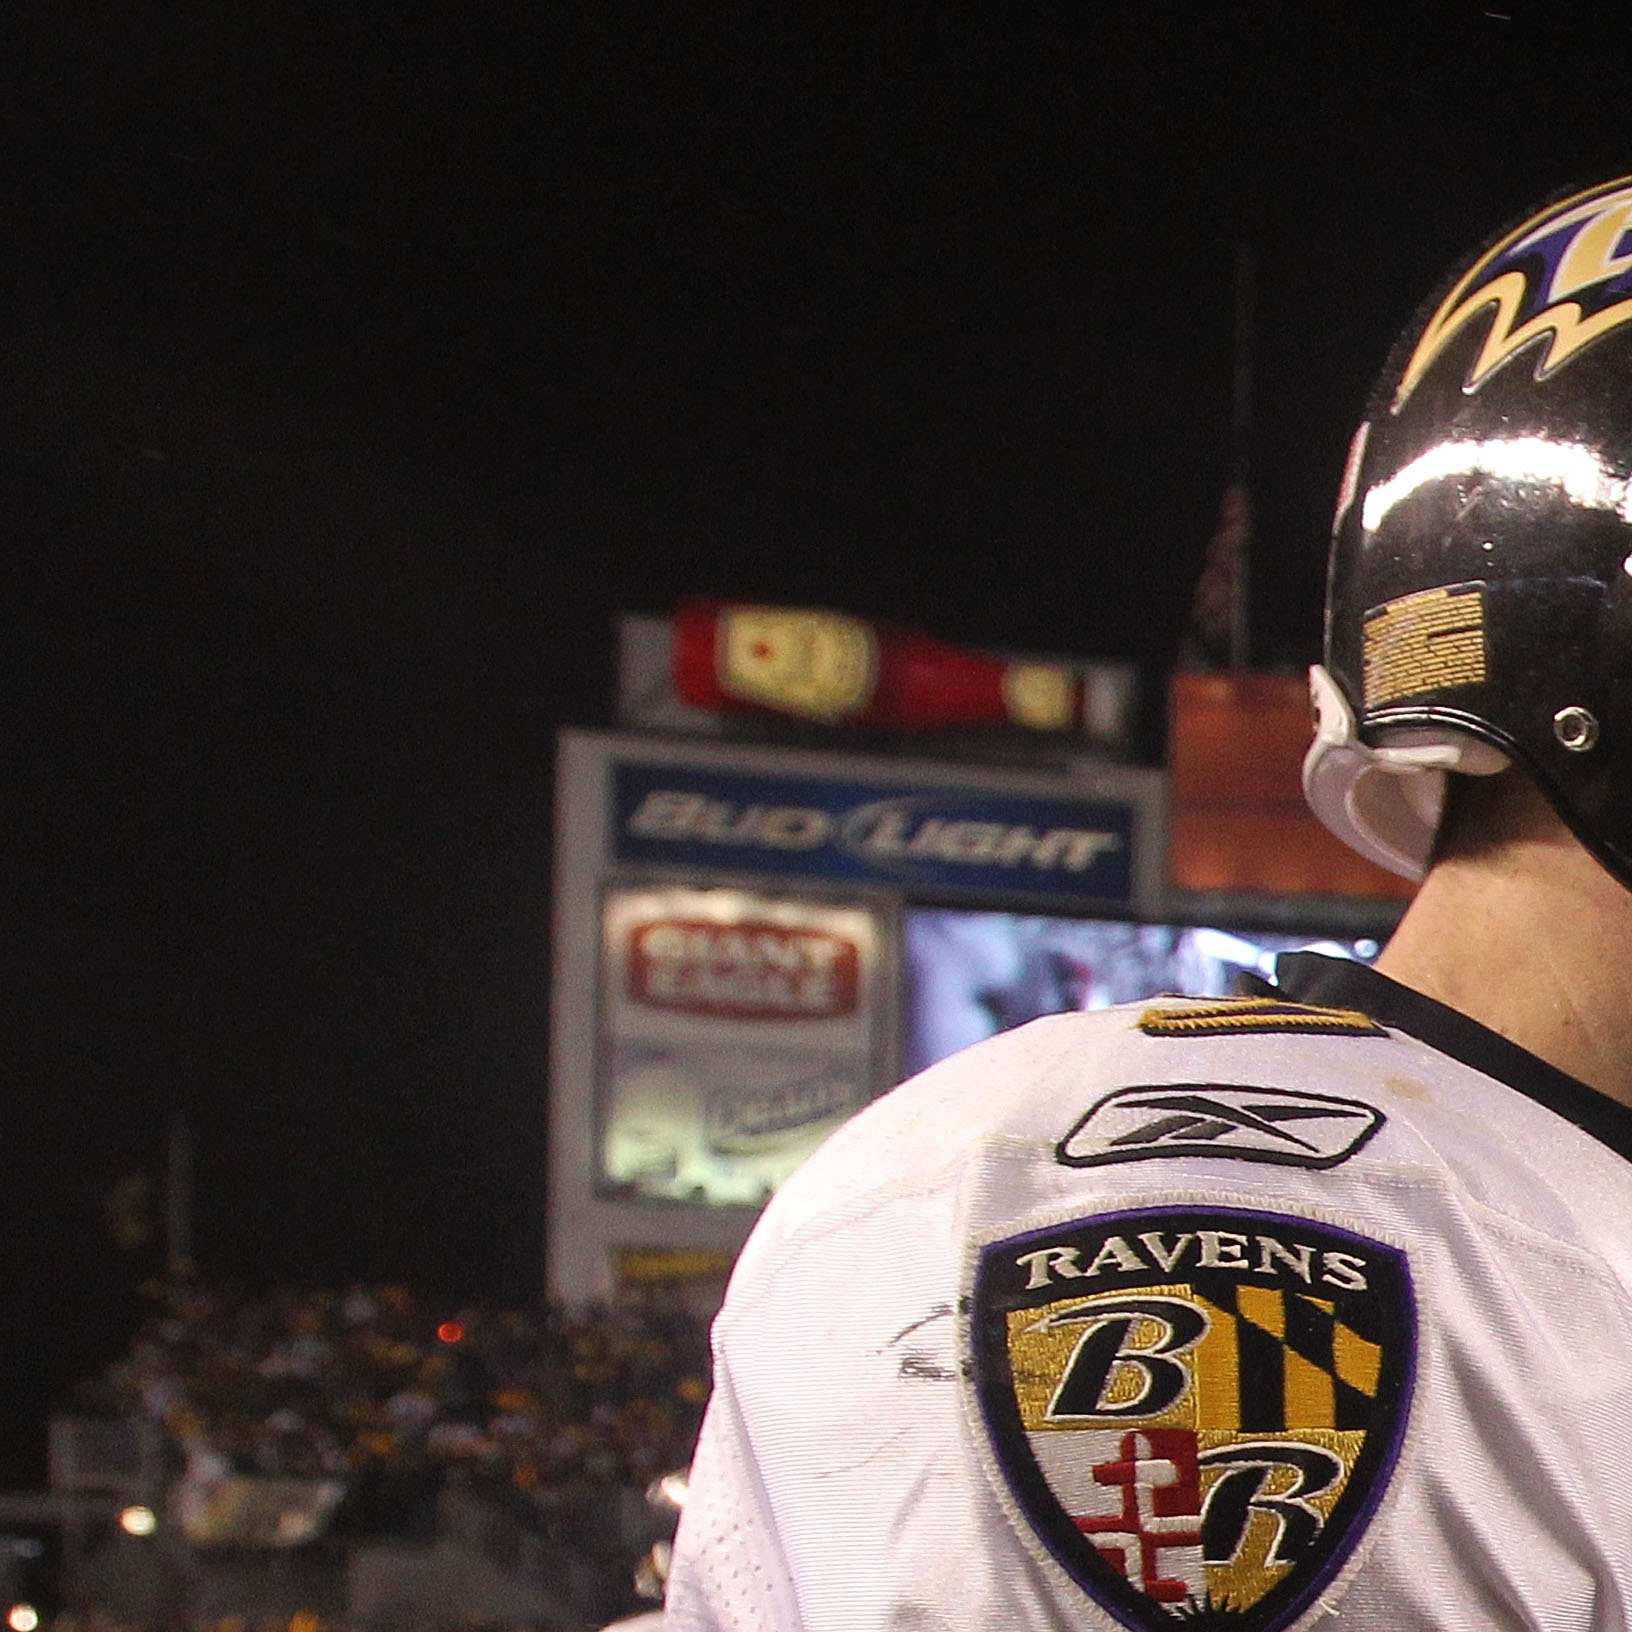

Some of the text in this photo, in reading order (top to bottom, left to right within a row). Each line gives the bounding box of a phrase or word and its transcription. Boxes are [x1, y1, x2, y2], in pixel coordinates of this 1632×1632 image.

[629, 790, 1120, 872] BUD LIGHT
[1016, 1231, 1369, 1291] RAVENS
[1021, 1294, 1212, 1423] B
[1197, 1440, 1346, 1568] R
